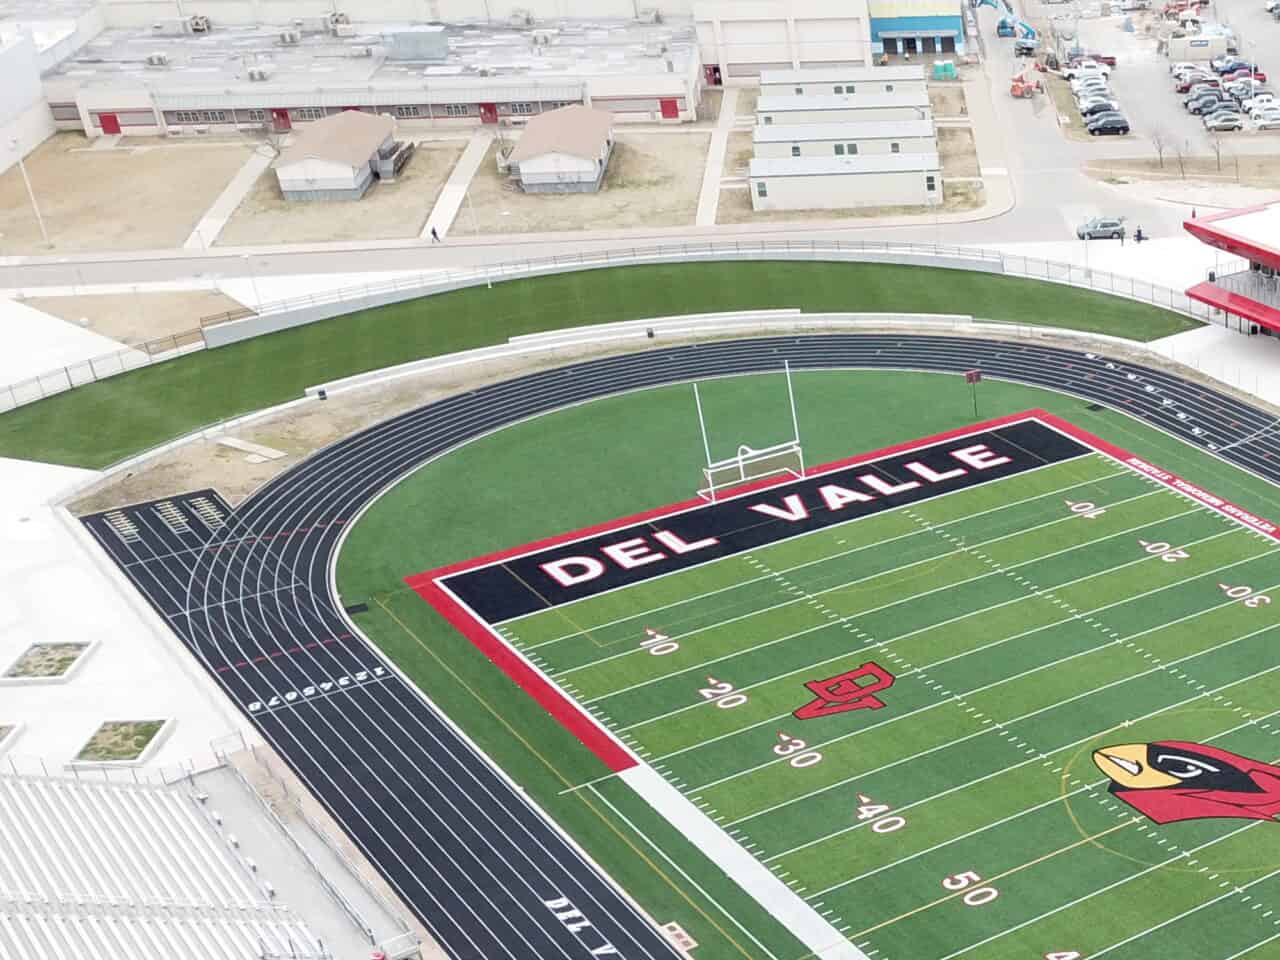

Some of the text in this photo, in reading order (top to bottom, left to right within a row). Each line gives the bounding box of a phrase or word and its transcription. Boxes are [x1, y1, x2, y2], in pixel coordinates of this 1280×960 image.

[539, 443, 1014, 588] DEL VALLE
[1070, 502, 1106, 519] 10
[1145, 541, 1191, 562] 20
[1226, 585, 1272, 608] 30
[640, 632, 679, 656] 10
[698, 682, 748, 709] 20
[773, 739, 823, 768] 30
[856, 803, 906, 833] 40
[941, 871, 999, 906] 50
[544, 896, 592, 934] DEL
